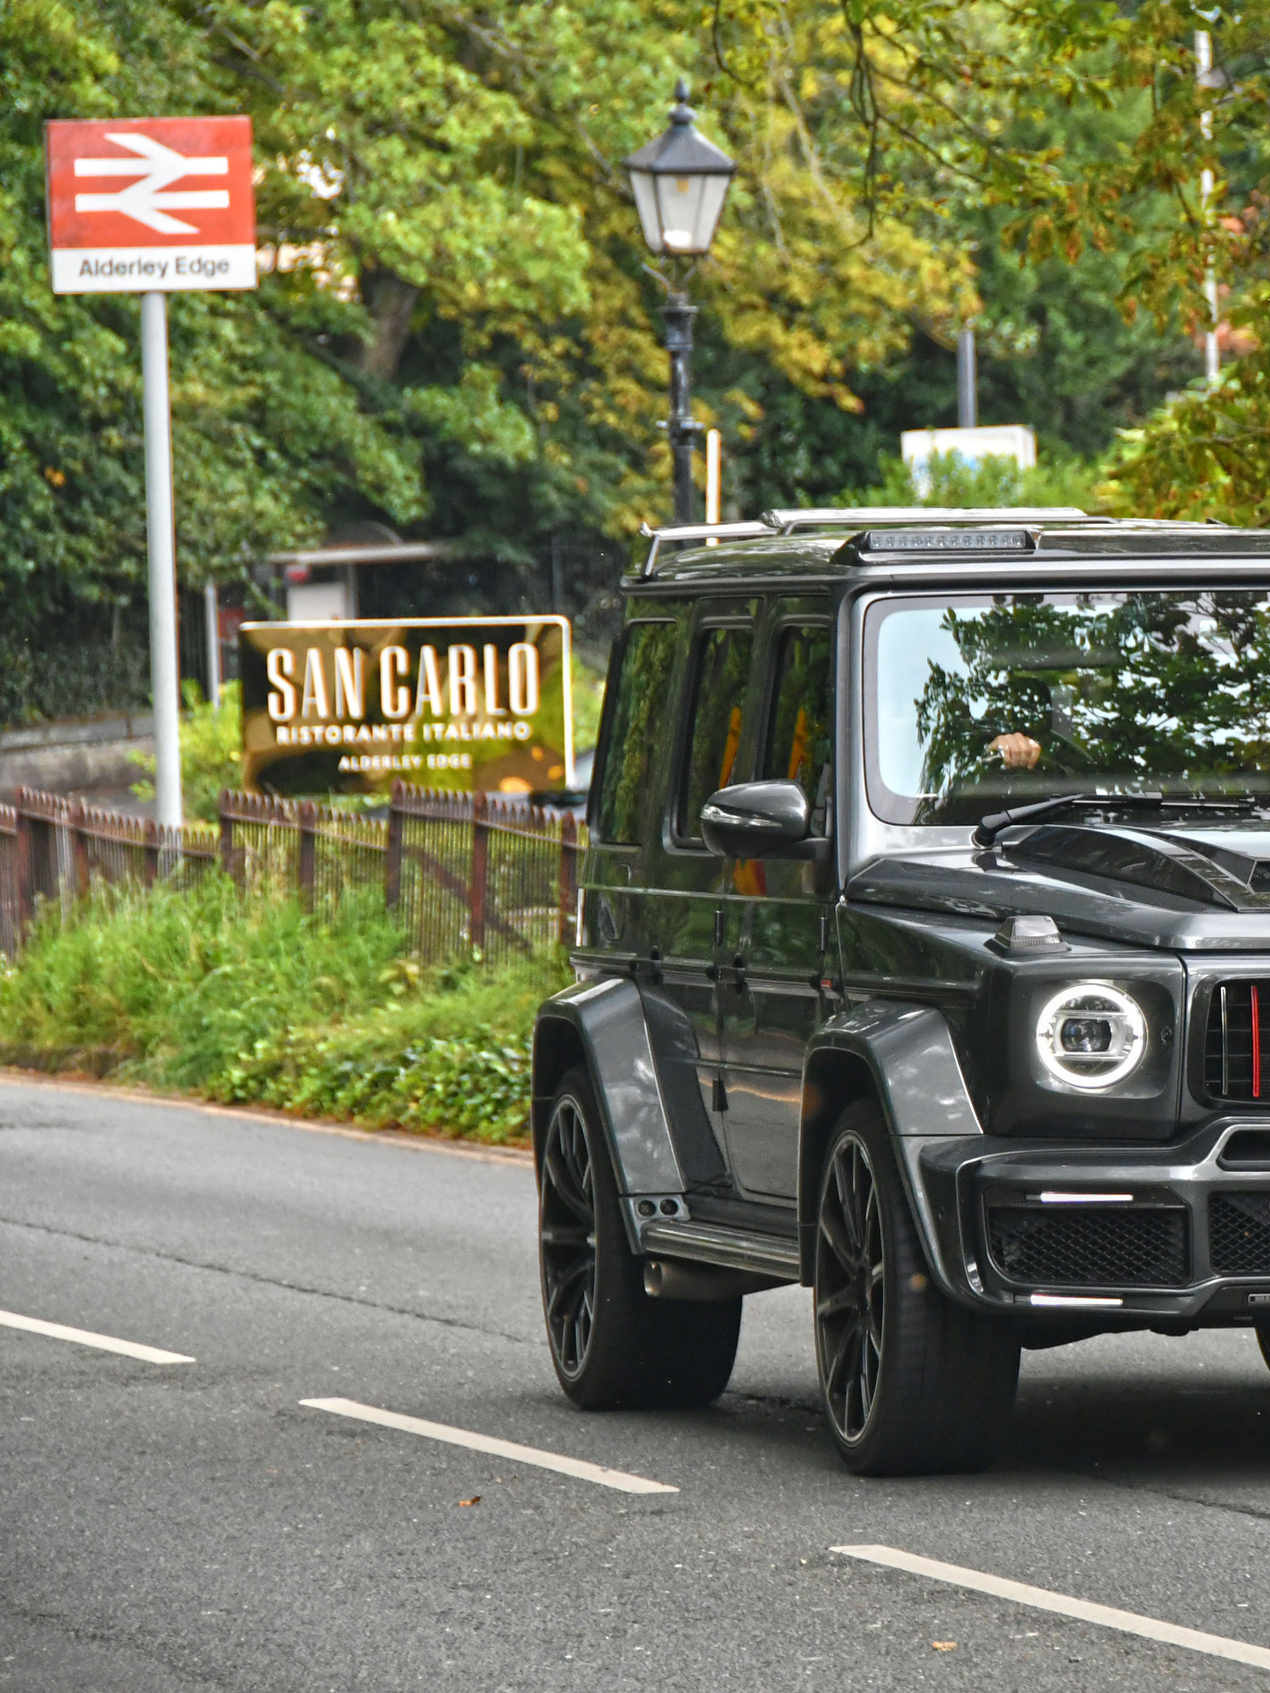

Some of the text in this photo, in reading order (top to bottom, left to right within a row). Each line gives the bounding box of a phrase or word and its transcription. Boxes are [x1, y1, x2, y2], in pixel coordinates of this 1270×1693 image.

[79, 256, 230, 279] Alderley Edge
[267, 642, 540, 721] SAN CARLO
[276, 721, 532, 745] RISTORANTE ITALIANO
[338, 753, 472, 771] ALDERLEY EDGE
